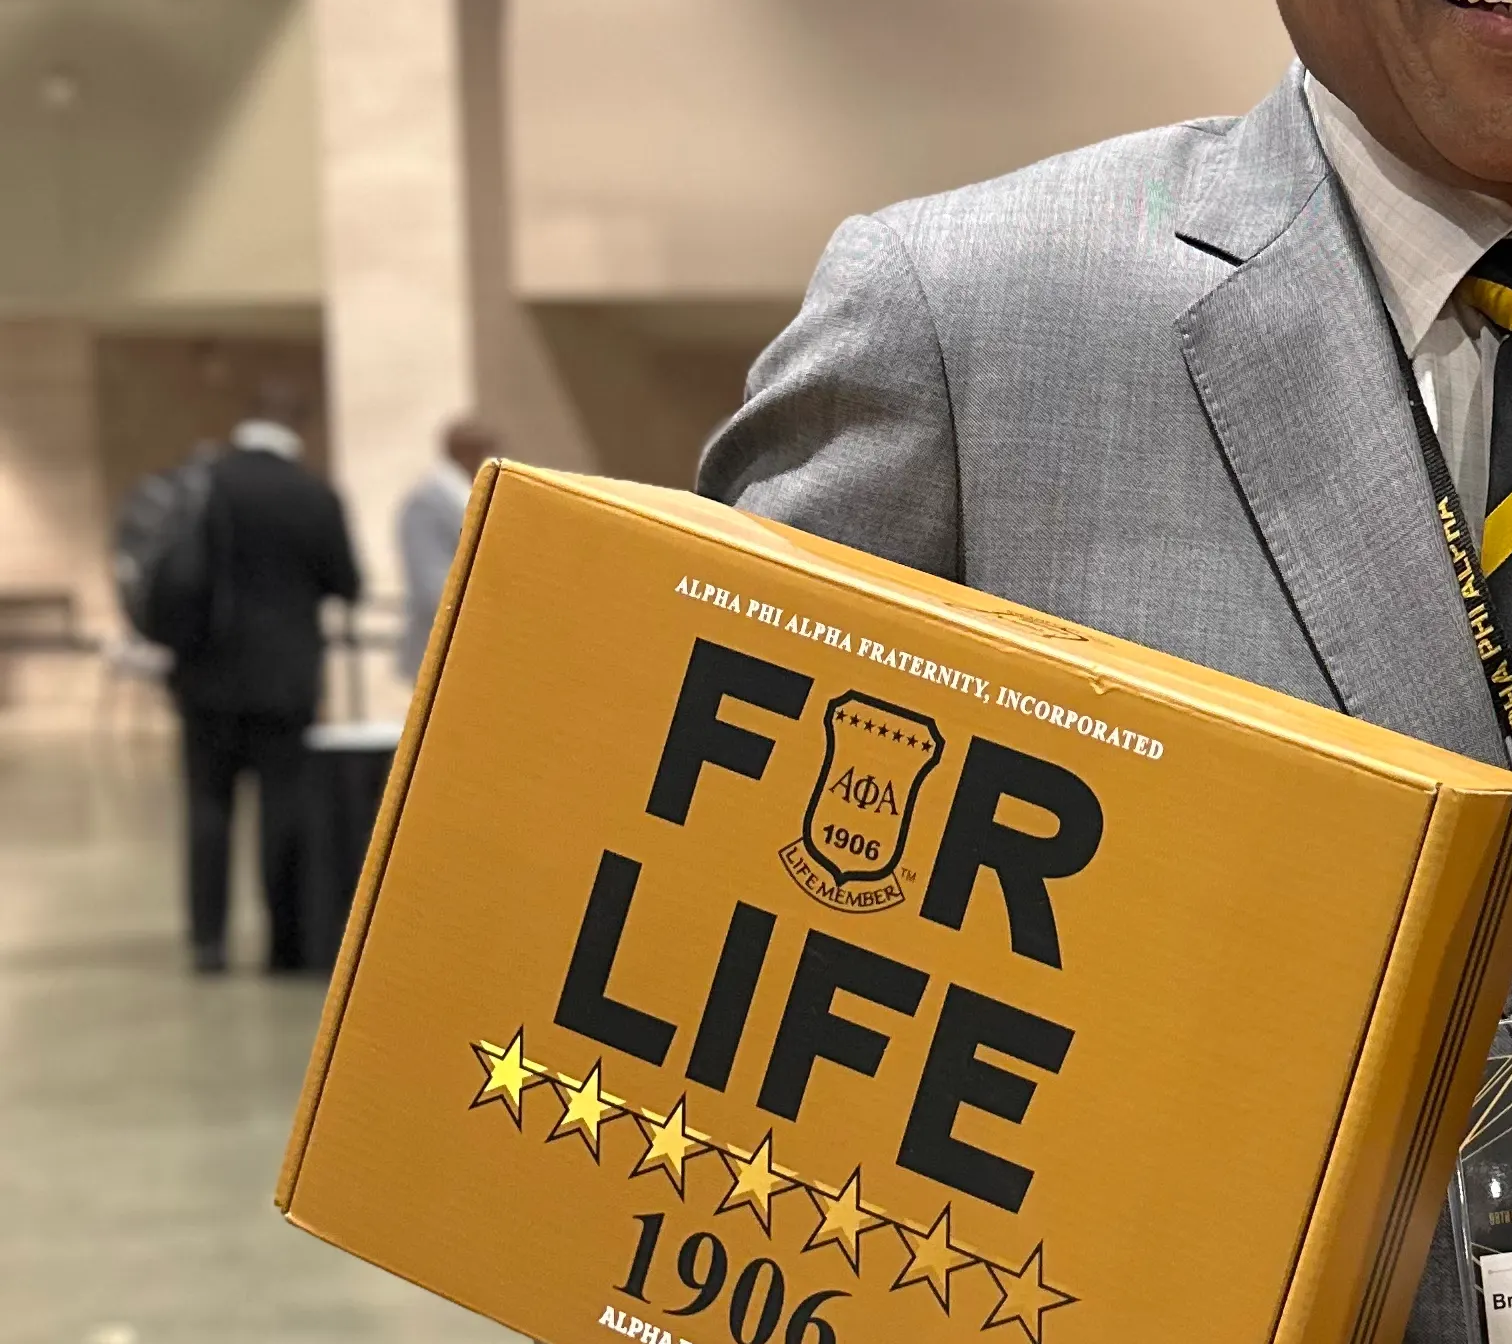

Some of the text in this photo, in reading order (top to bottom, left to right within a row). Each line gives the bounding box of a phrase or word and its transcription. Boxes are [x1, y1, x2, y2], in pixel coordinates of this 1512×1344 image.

[1438, 495, 1481, 600] ALPHA
[1468, 603, 1502, 660] PHI
[674, 575, 1165, 760] ALPHA PHI ALPHA FRATERNITY, INCORPORATED
[785, 846, 902, 907] LIFE MEMBER
[823, 824, 881, 861] 1906
[553, 849, 1075, 1216] LIFE
